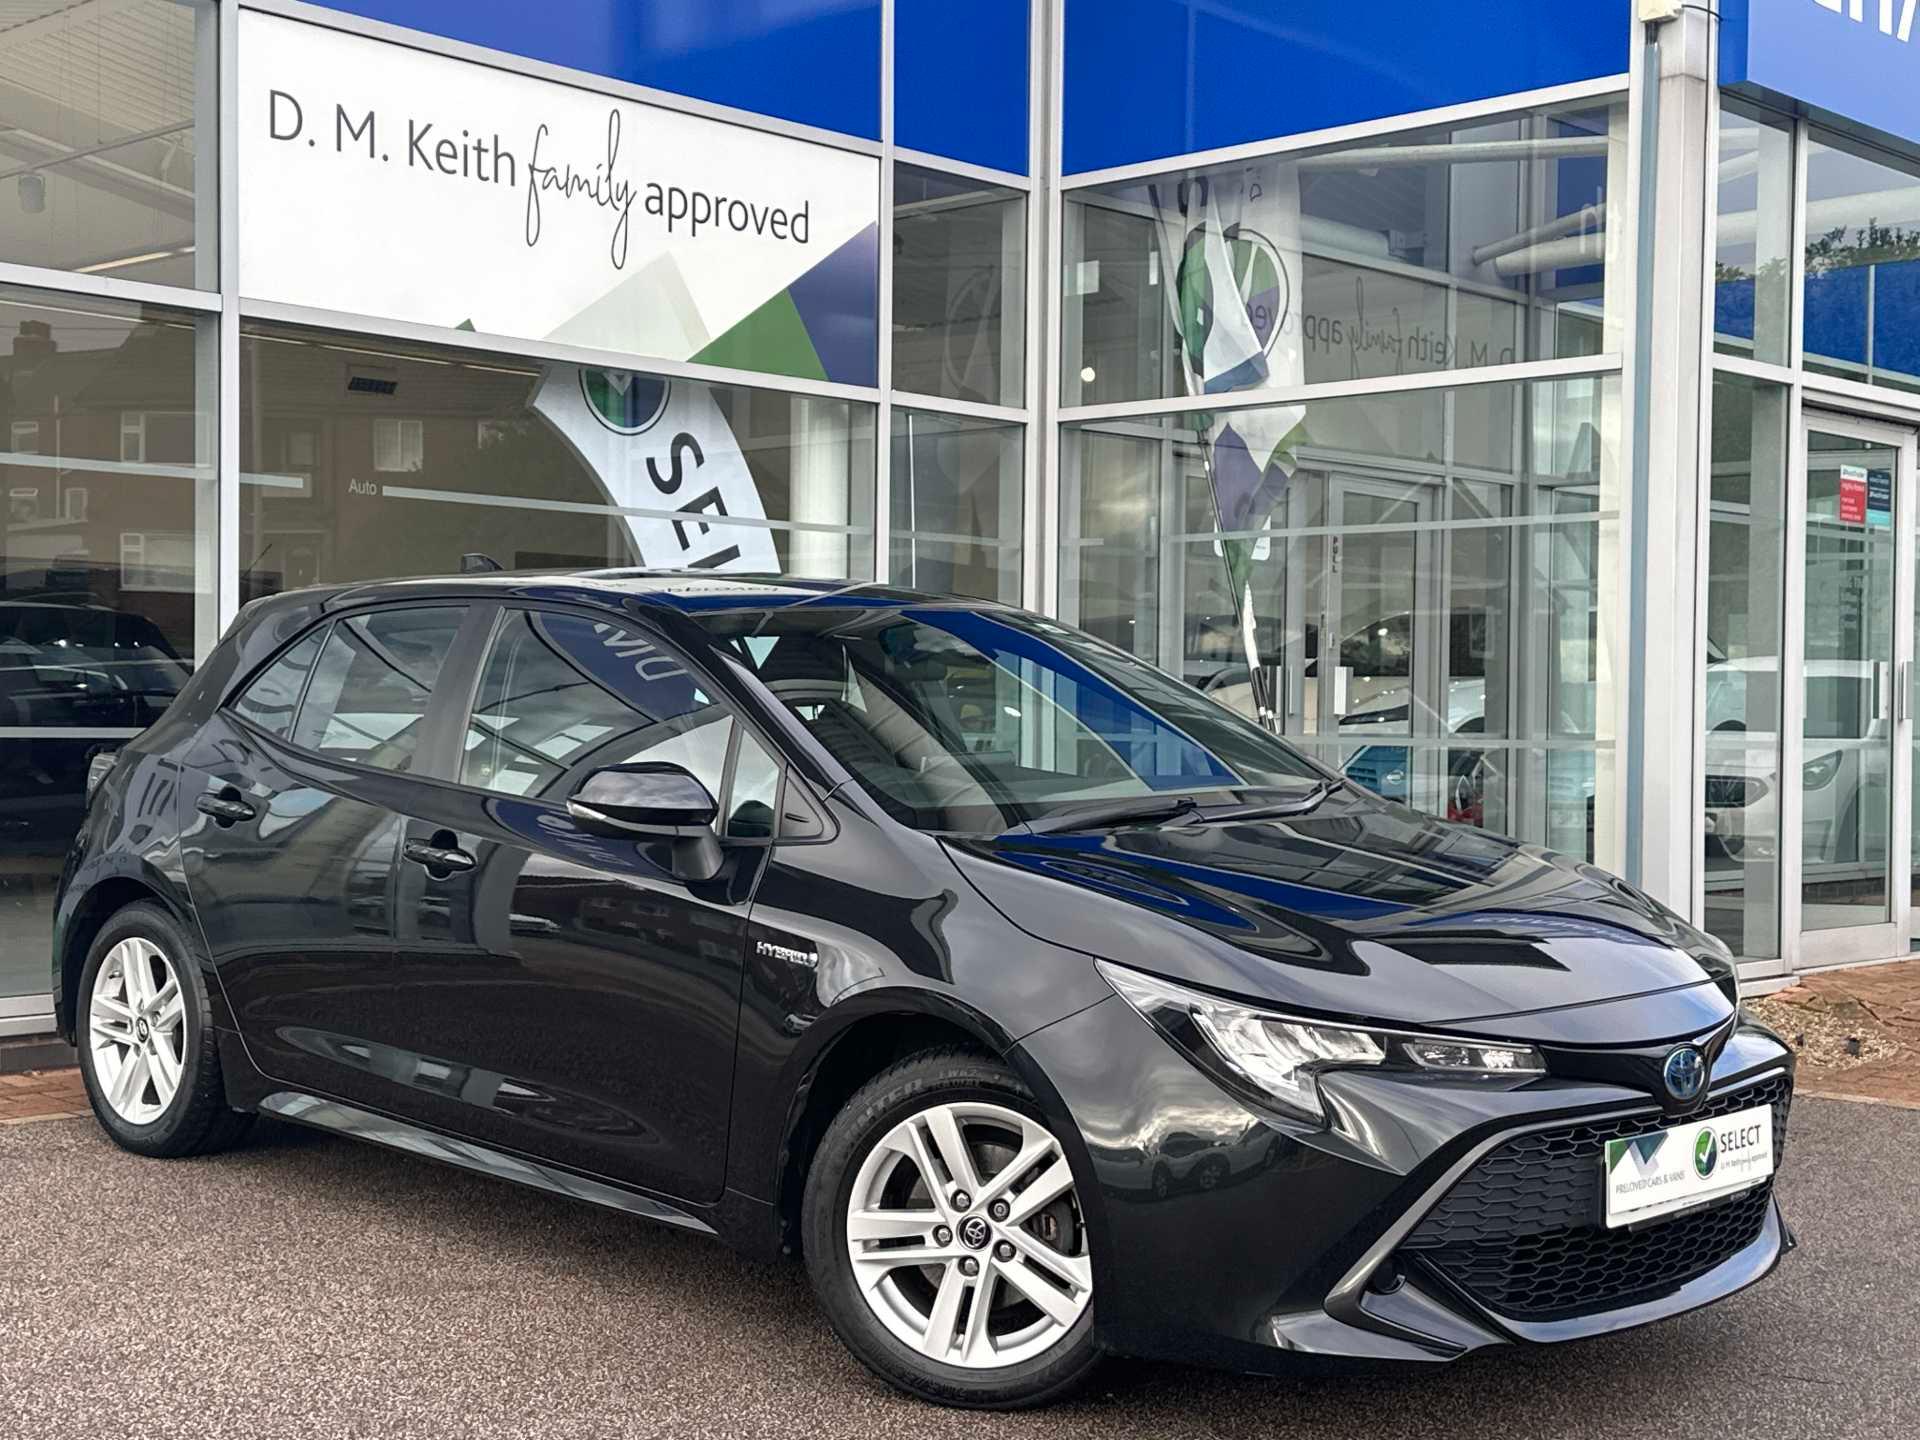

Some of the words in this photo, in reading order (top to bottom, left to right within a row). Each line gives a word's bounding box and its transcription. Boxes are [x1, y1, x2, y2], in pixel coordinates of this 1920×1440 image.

[269, 90, 316, 148] D.
[335, 103, 390, 162] M.
[408, 119, 516, 187] Keith
[526, 109, 637, 270] family
[645, 179, 809, 244] approved
[348, 478, 377, 496] Auto
[1331, 535, 1339, 574] PULL
[756, 941, 808, 962] HYBRID
[1720, 1124, 1762, 1154] SELECT
[1647, 1176, 1663, 1188] CARS
[1663, 1174, 1669, 1184] &
